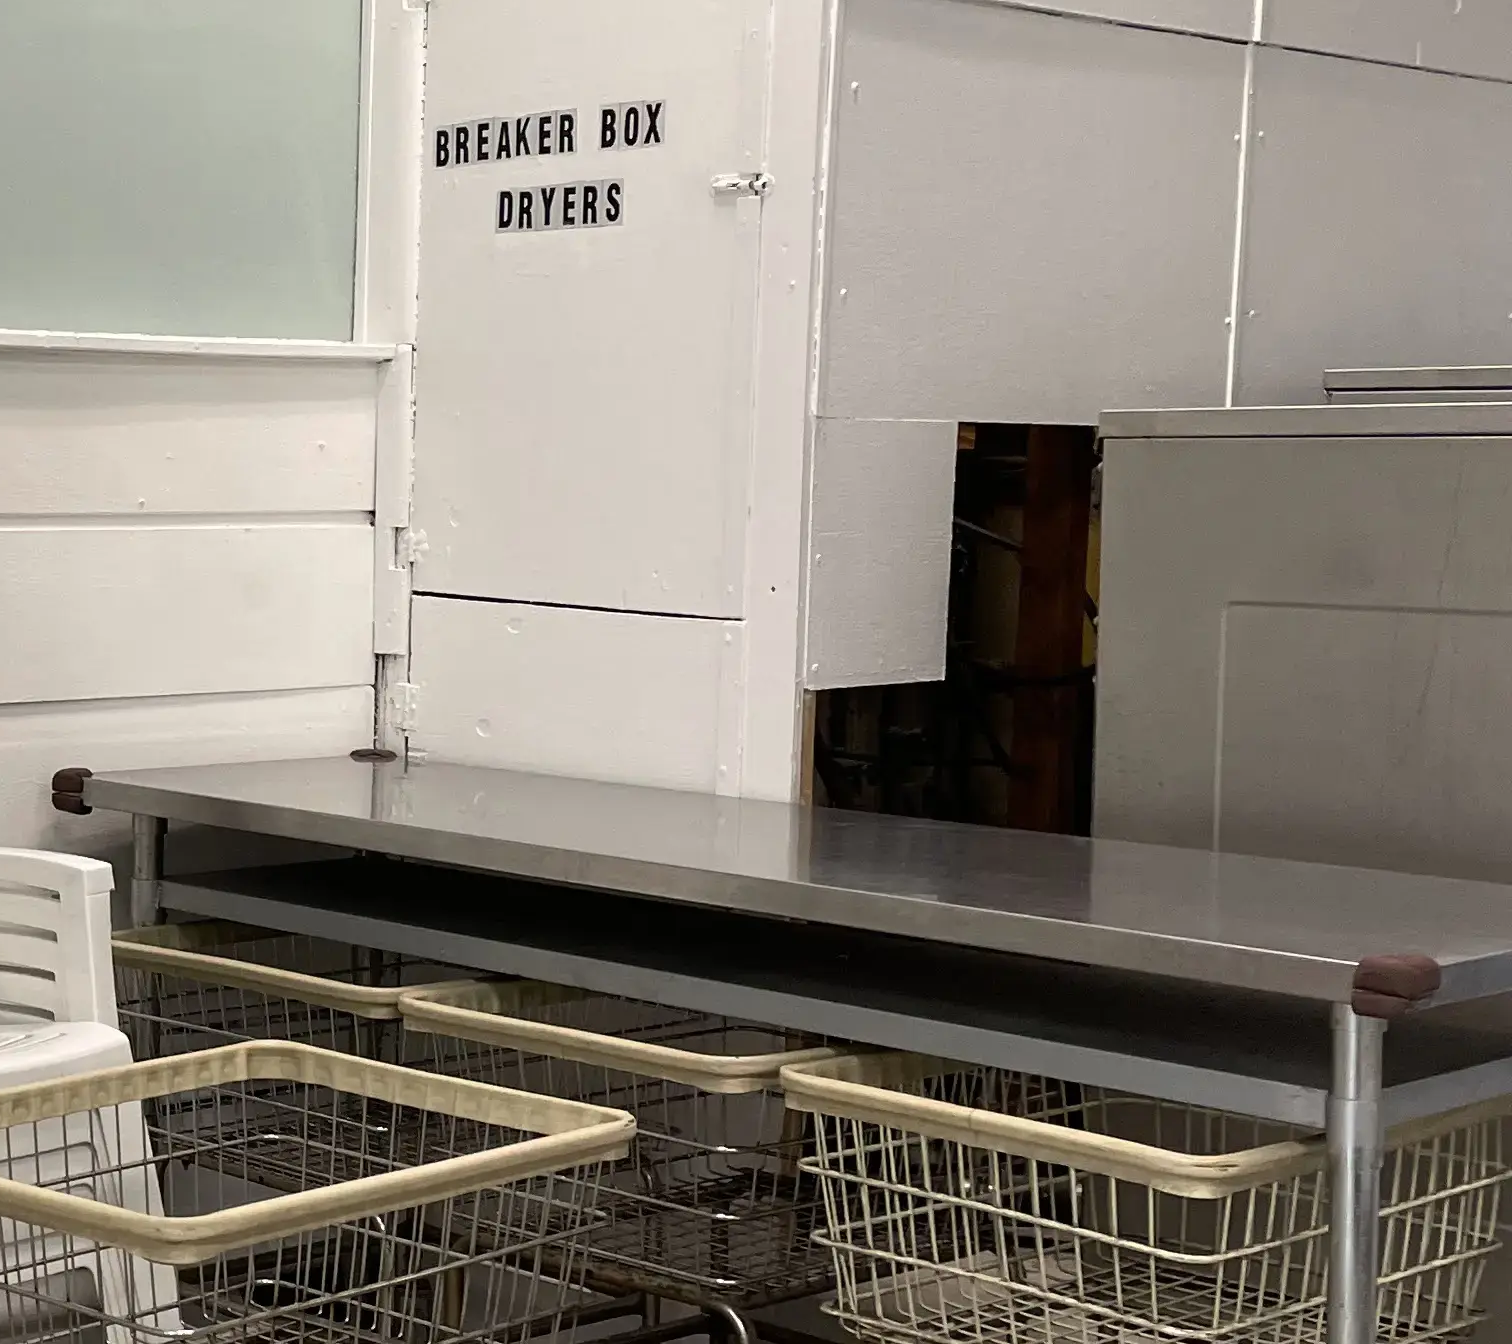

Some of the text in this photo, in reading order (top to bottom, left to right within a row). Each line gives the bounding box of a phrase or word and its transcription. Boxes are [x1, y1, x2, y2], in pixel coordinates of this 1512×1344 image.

[435, 102, 663, 168] BREAKER BOX
[498, 182, 621, 230] DRYERS
